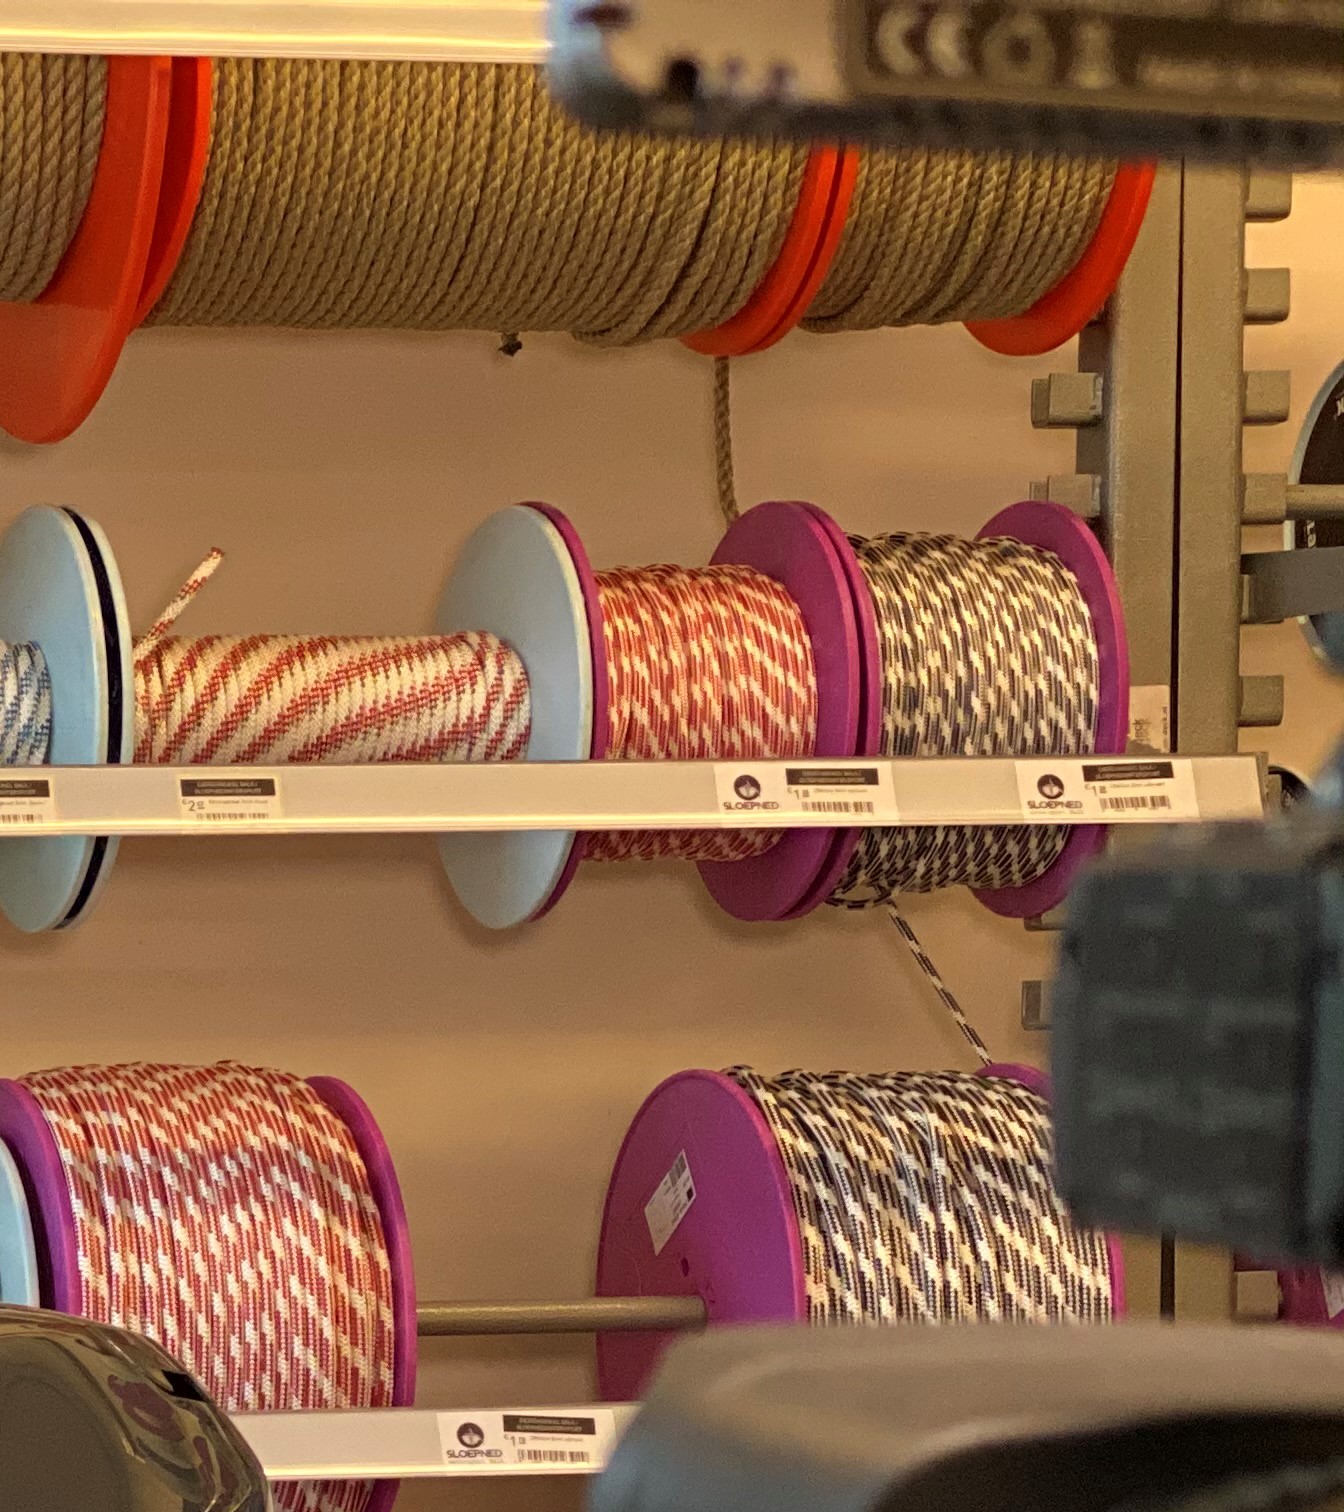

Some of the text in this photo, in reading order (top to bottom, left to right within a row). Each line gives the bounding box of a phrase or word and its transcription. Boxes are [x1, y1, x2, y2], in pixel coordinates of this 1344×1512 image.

[723, 801, 780, 810] SLOEPNED
[1027, 800, 1083, 809] SLOEPNED
[446, 1449, 503, 1459] SLOEPNED
